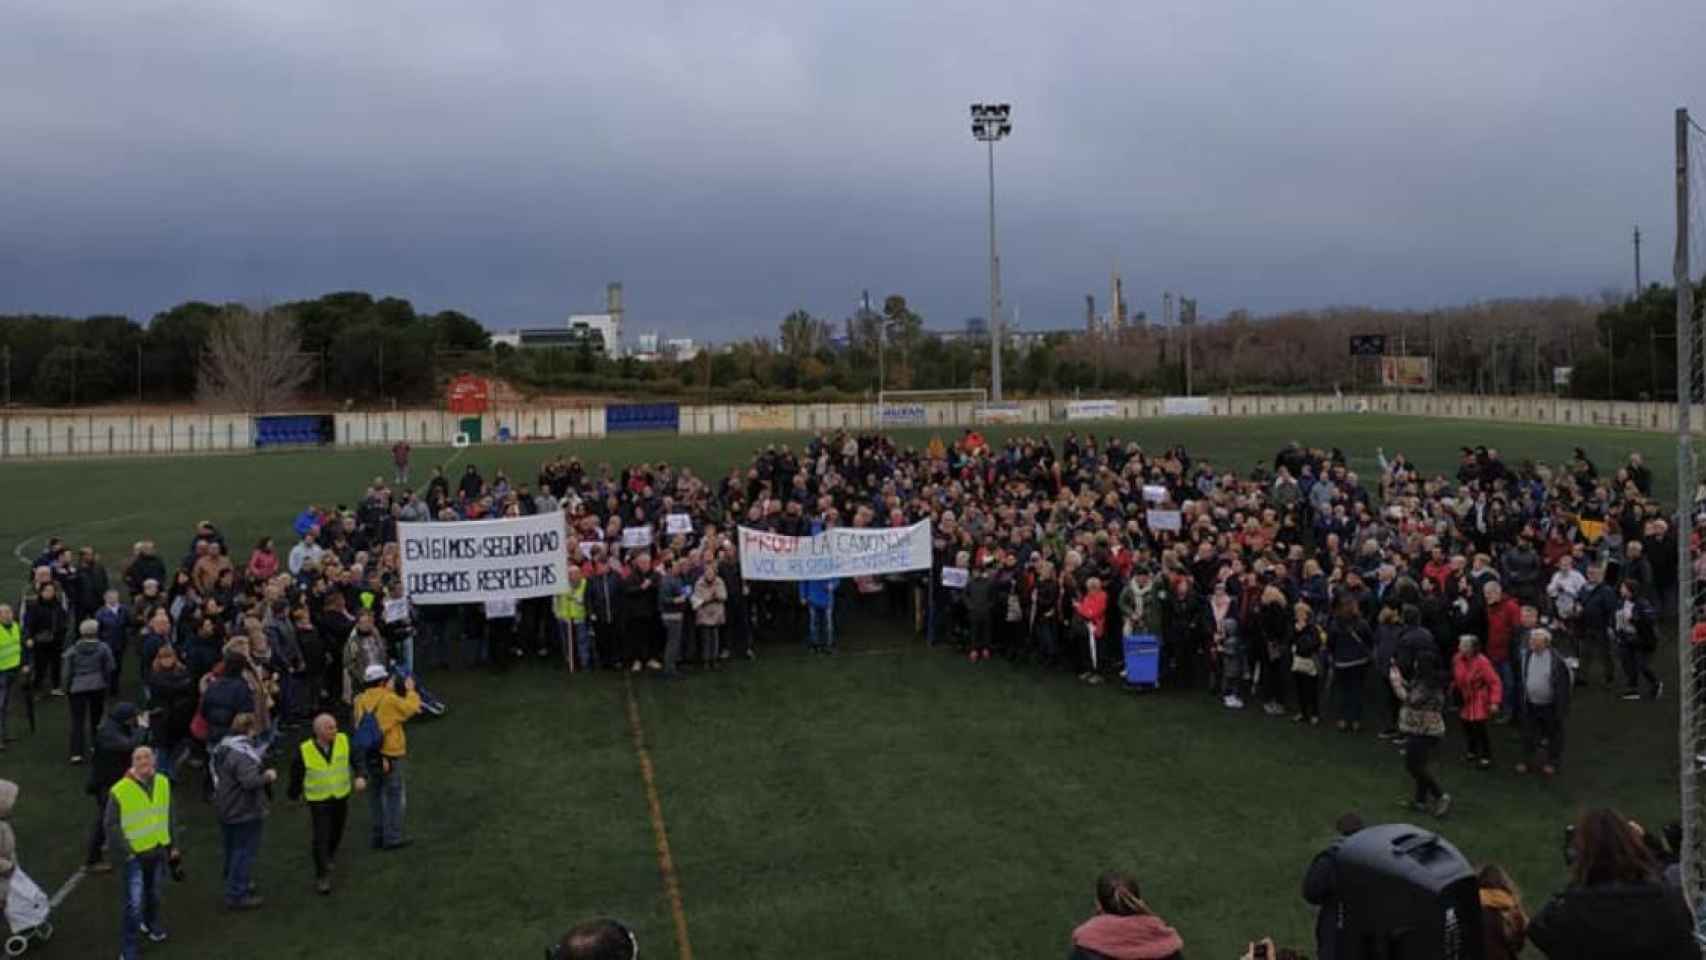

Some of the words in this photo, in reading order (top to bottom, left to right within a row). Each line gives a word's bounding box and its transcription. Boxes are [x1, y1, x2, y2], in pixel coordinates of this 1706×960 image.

[405, 536, 476, 560] EXIGIMOS
[483, 530, 559, 558] SEGURIDAD
[477, 563, 557, 591] RESPUESTAS
